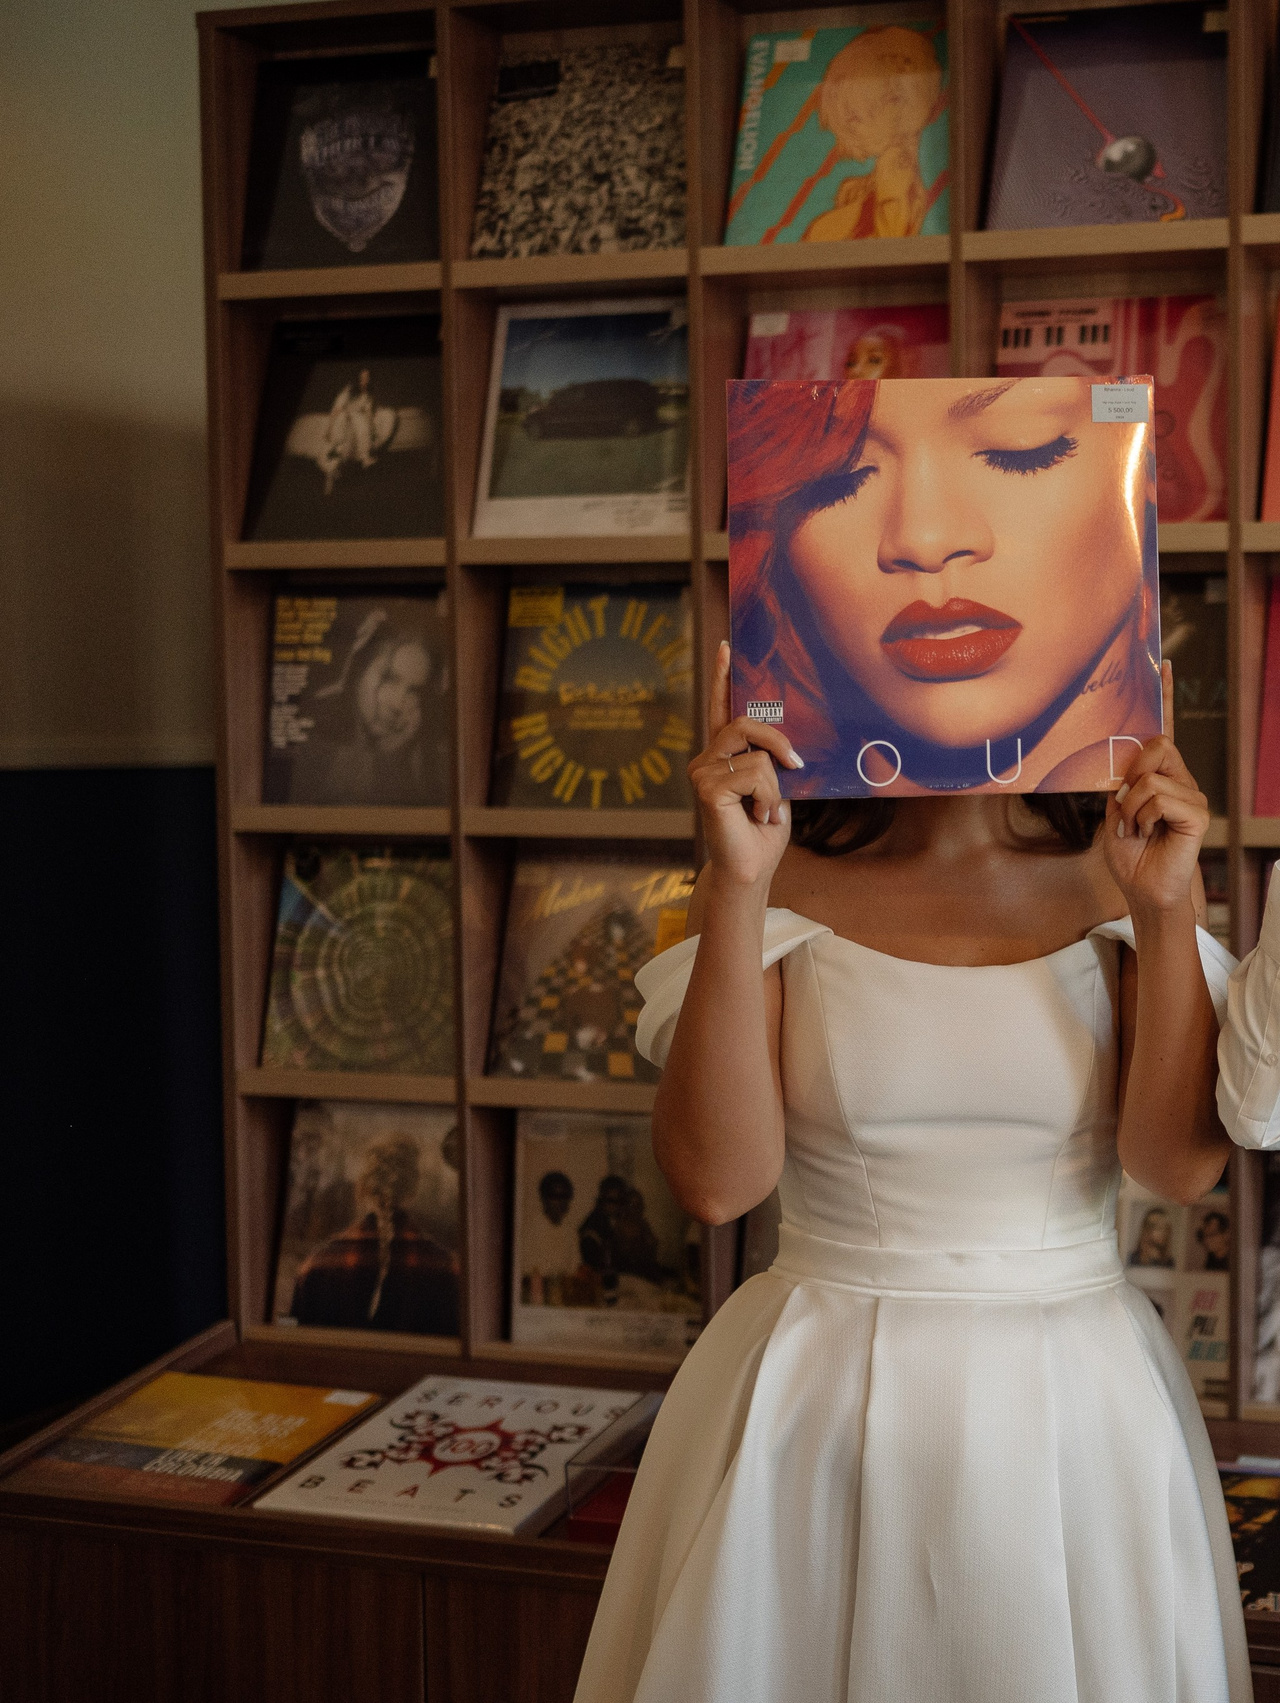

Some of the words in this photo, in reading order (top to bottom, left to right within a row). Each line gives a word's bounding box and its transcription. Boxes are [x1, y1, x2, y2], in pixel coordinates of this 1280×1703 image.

[737, 40, 770, 172] EVANGELION
[749, 708, 782, 717] ADVISORY
[511, 712, 608, 809] RIGHT
[748, 736, 1145, 788] OUD
[297, 1474, 523, 1508] BEATS
